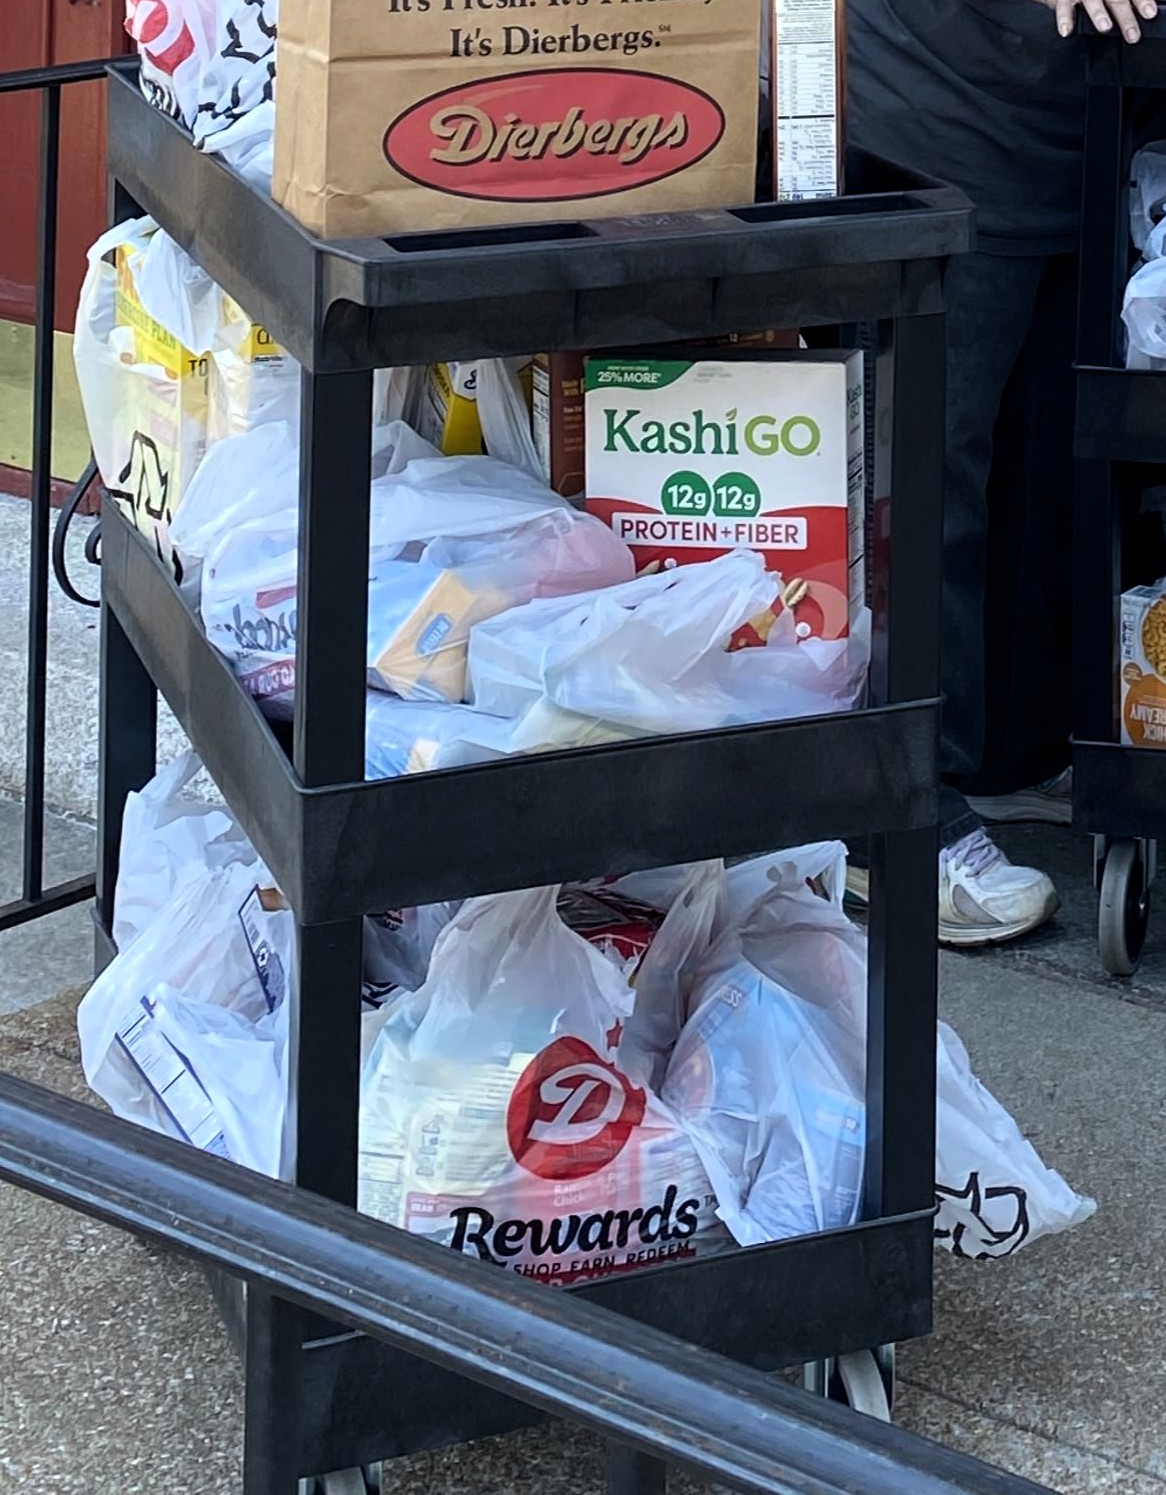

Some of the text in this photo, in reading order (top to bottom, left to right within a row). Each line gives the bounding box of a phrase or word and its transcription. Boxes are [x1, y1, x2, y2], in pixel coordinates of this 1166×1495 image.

[450, 27, 493, 58] It's
[502, 23, 662, 57] Dierbergs.
[429, 104, 690, 168] Dierbergs
[597, 371, 623, 383] 25%
[603, 408, 739, 455] Kashi
[743, 415, 821, 457] GO
[667, 485, 756, 511] 12g 12g
[620, 518, 717, 542] PROTEIN
[735, 523, 799, 544] FIBER
[450, 1185, 701, 1268] Rewards
